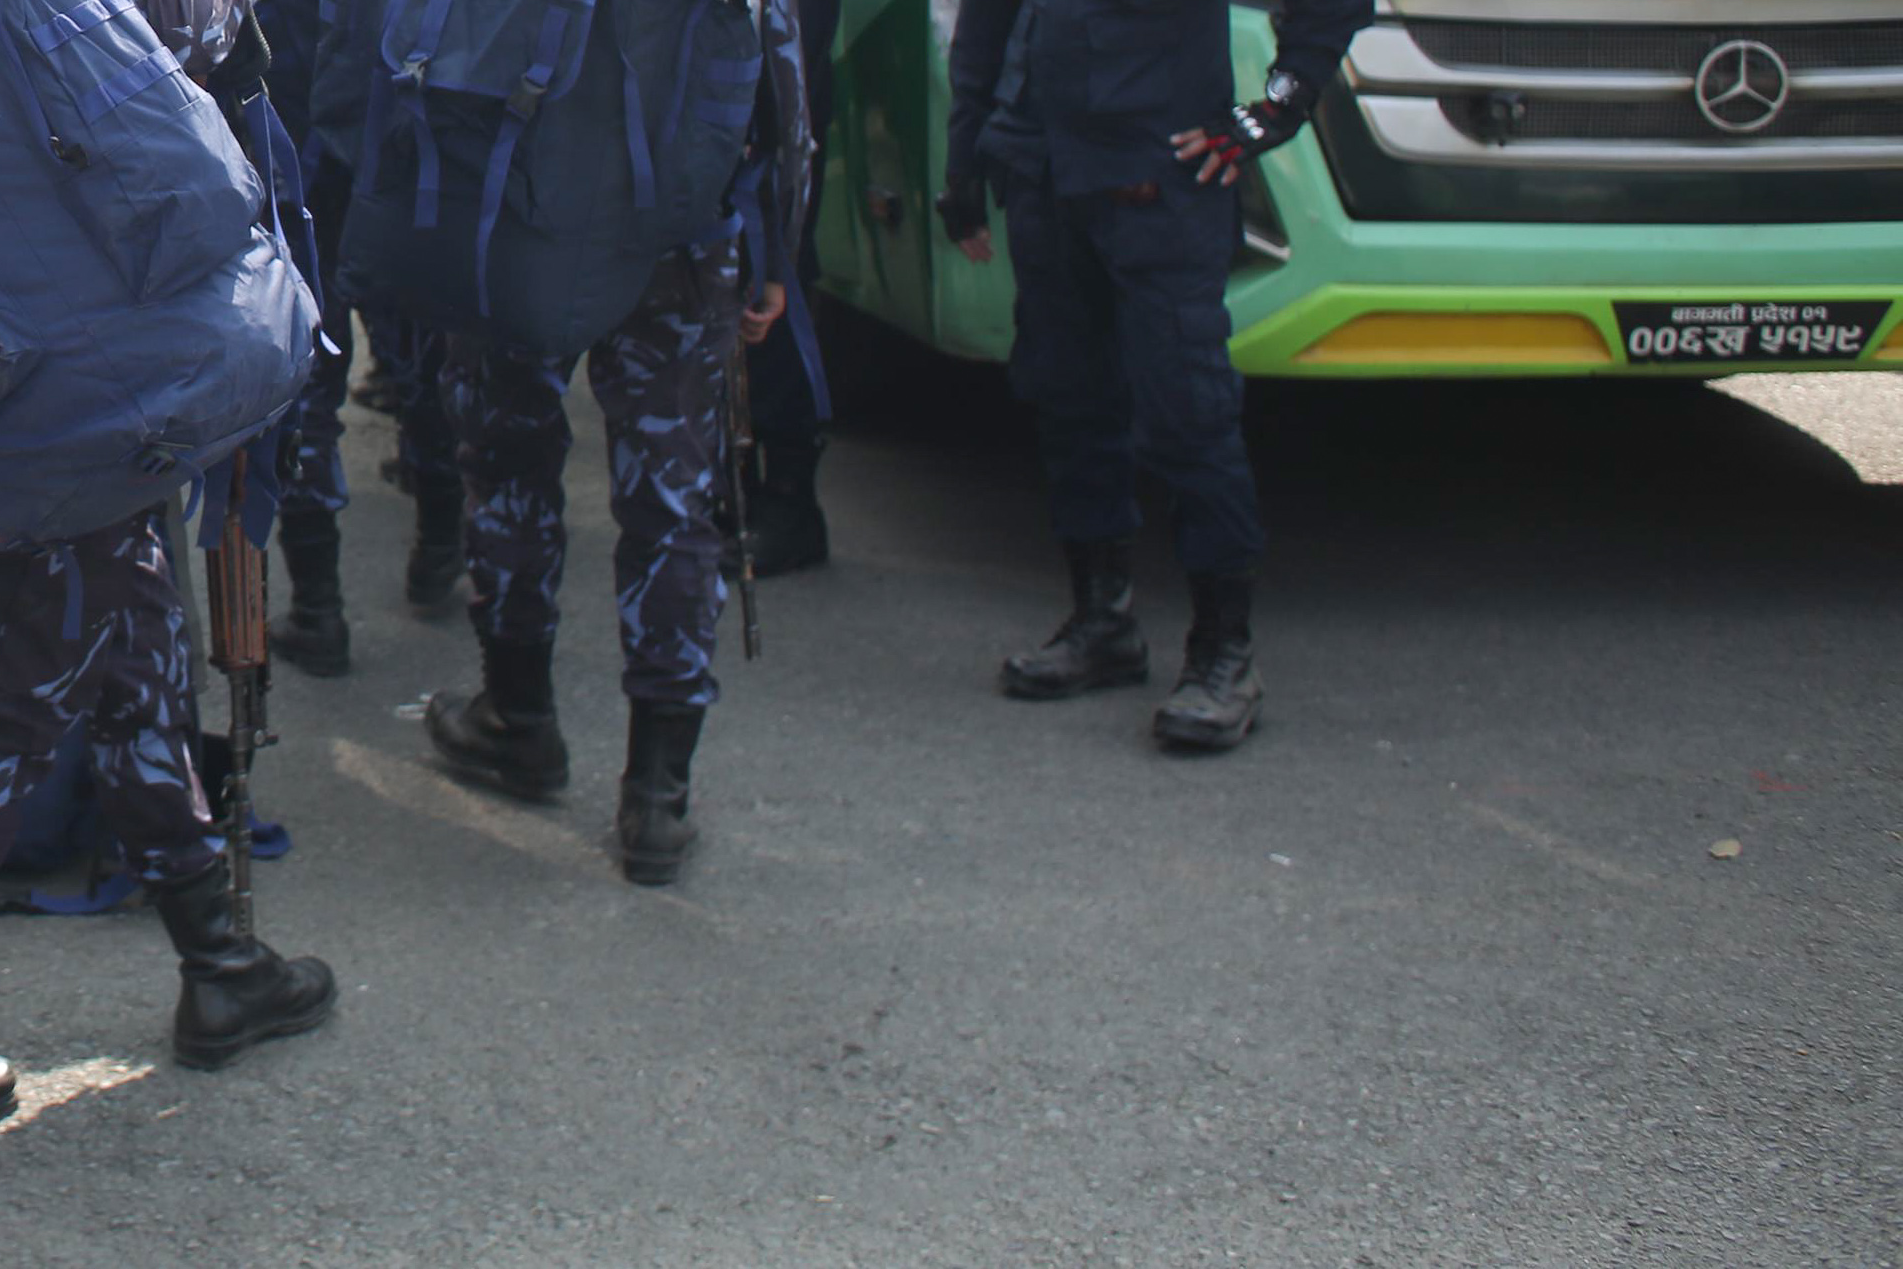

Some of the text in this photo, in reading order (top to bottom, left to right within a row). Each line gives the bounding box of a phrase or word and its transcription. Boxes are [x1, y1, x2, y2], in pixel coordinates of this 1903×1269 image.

[1671, 302, 1829, 324] बागमती प्रदेश ०१
